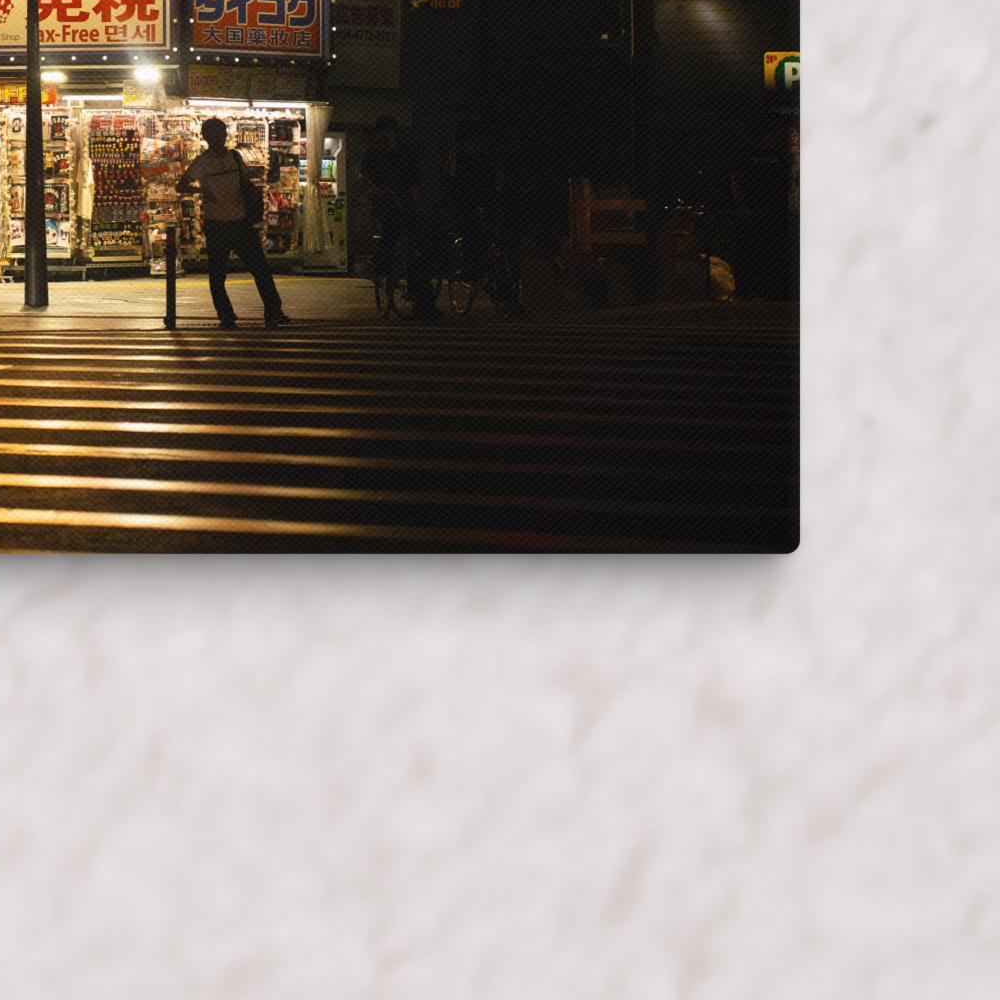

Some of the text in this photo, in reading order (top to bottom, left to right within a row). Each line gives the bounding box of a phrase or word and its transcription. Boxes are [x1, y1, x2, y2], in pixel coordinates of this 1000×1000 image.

[0, 34, 20, 43] Shop
[26, 25, 156, 43] ax-Free 면세
